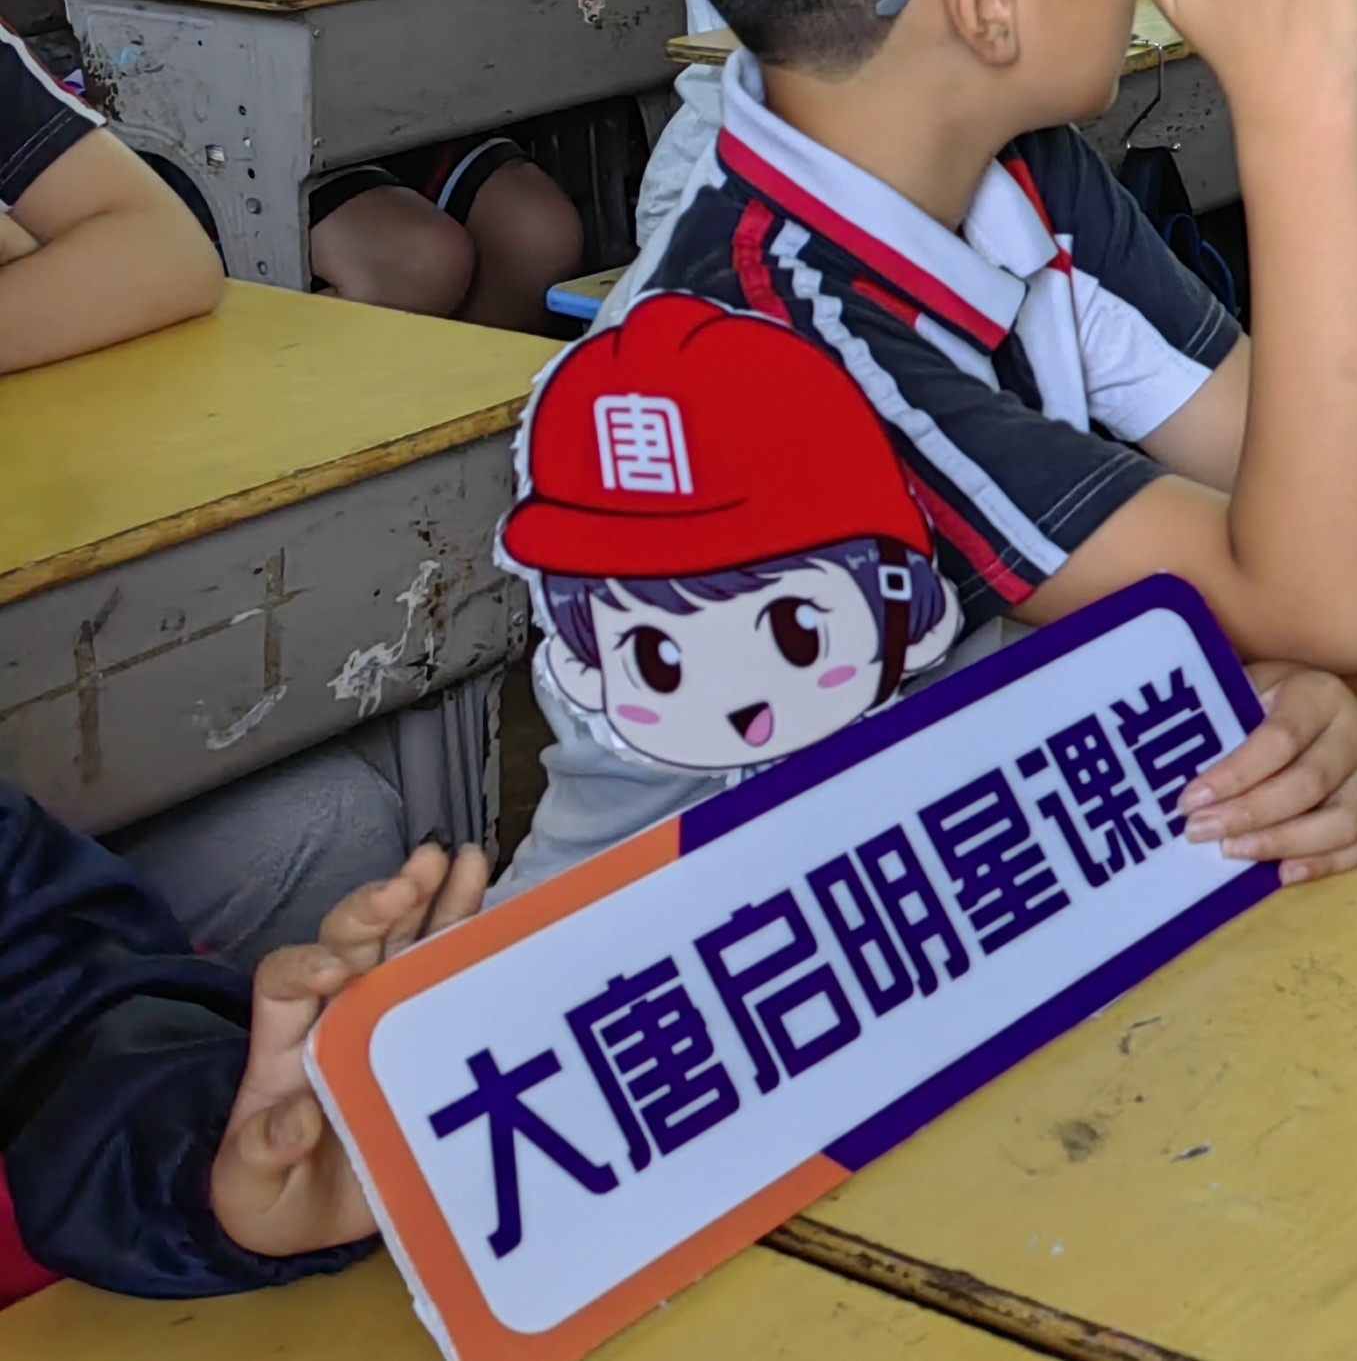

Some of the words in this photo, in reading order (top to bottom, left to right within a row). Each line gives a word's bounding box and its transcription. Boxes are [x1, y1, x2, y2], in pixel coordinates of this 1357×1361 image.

[594, 393, 694, 495] 唐
[427, 665, 1226, 1260] 大唐启明星课堂
